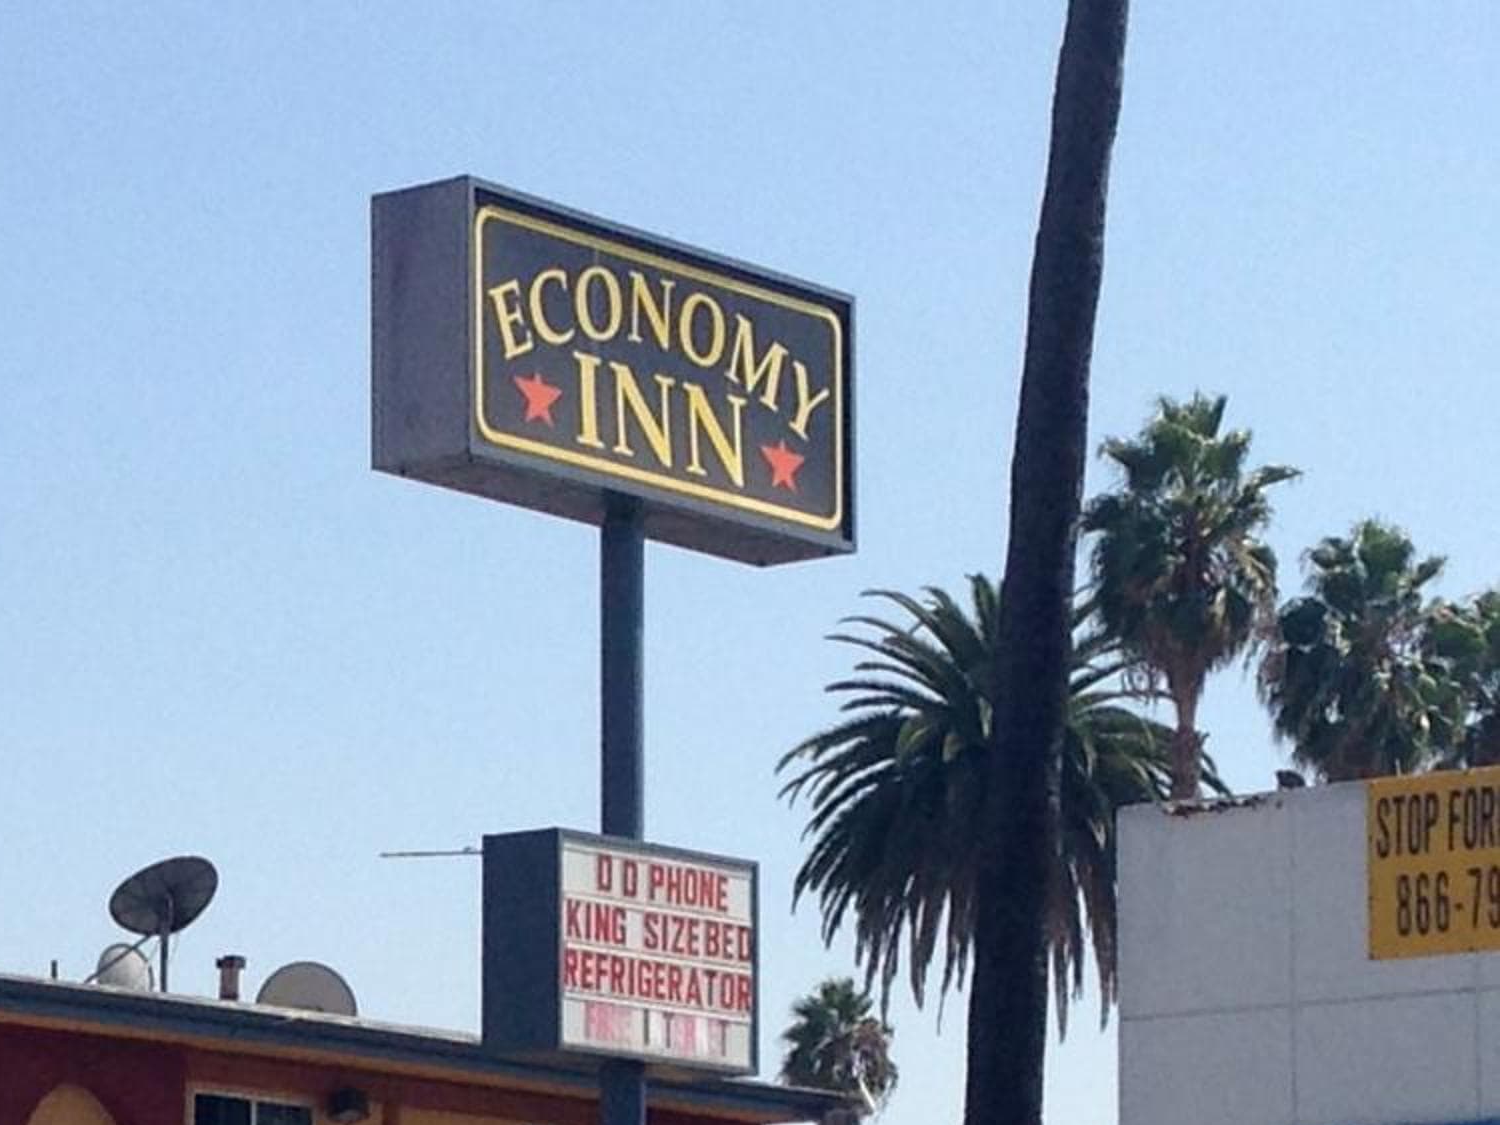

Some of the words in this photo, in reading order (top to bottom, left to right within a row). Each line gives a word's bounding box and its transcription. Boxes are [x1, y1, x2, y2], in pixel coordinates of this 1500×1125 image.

[489, 266, 830, 440] ECONOMY
[573, 351, 748, 488] INN
[1376, 793, 1439, 858] STOP
[1448, 787, 1500, 851] FOR
[650, 863, 729, 912] PHONE
[566, 898, 627, 945] KING
[564, 948, 750, 1011] REFRIGERATOR
